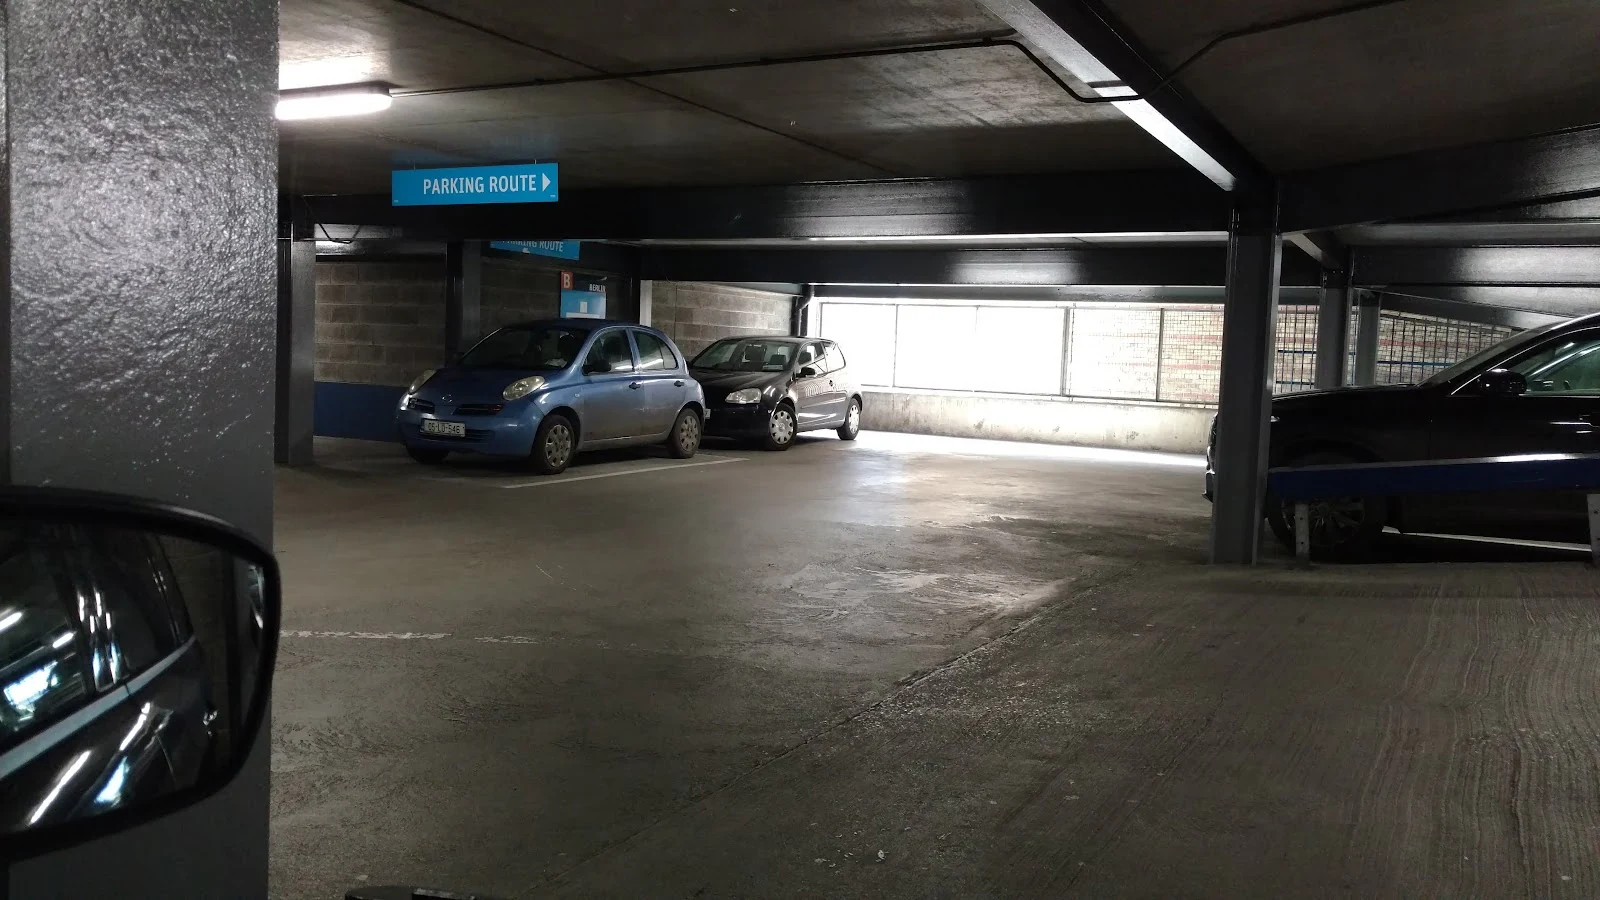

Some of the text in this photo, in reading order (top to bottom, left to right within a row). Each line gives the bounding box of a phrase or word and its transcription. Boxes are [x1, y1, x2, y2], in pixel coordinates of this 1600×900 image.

[423, 174, 537, 195] PARKING ROUTE
[539, 241, 564, 252] ROUTE
[563, 273, 571, 289] B
[589, 283, 606, 293] BERLIN
